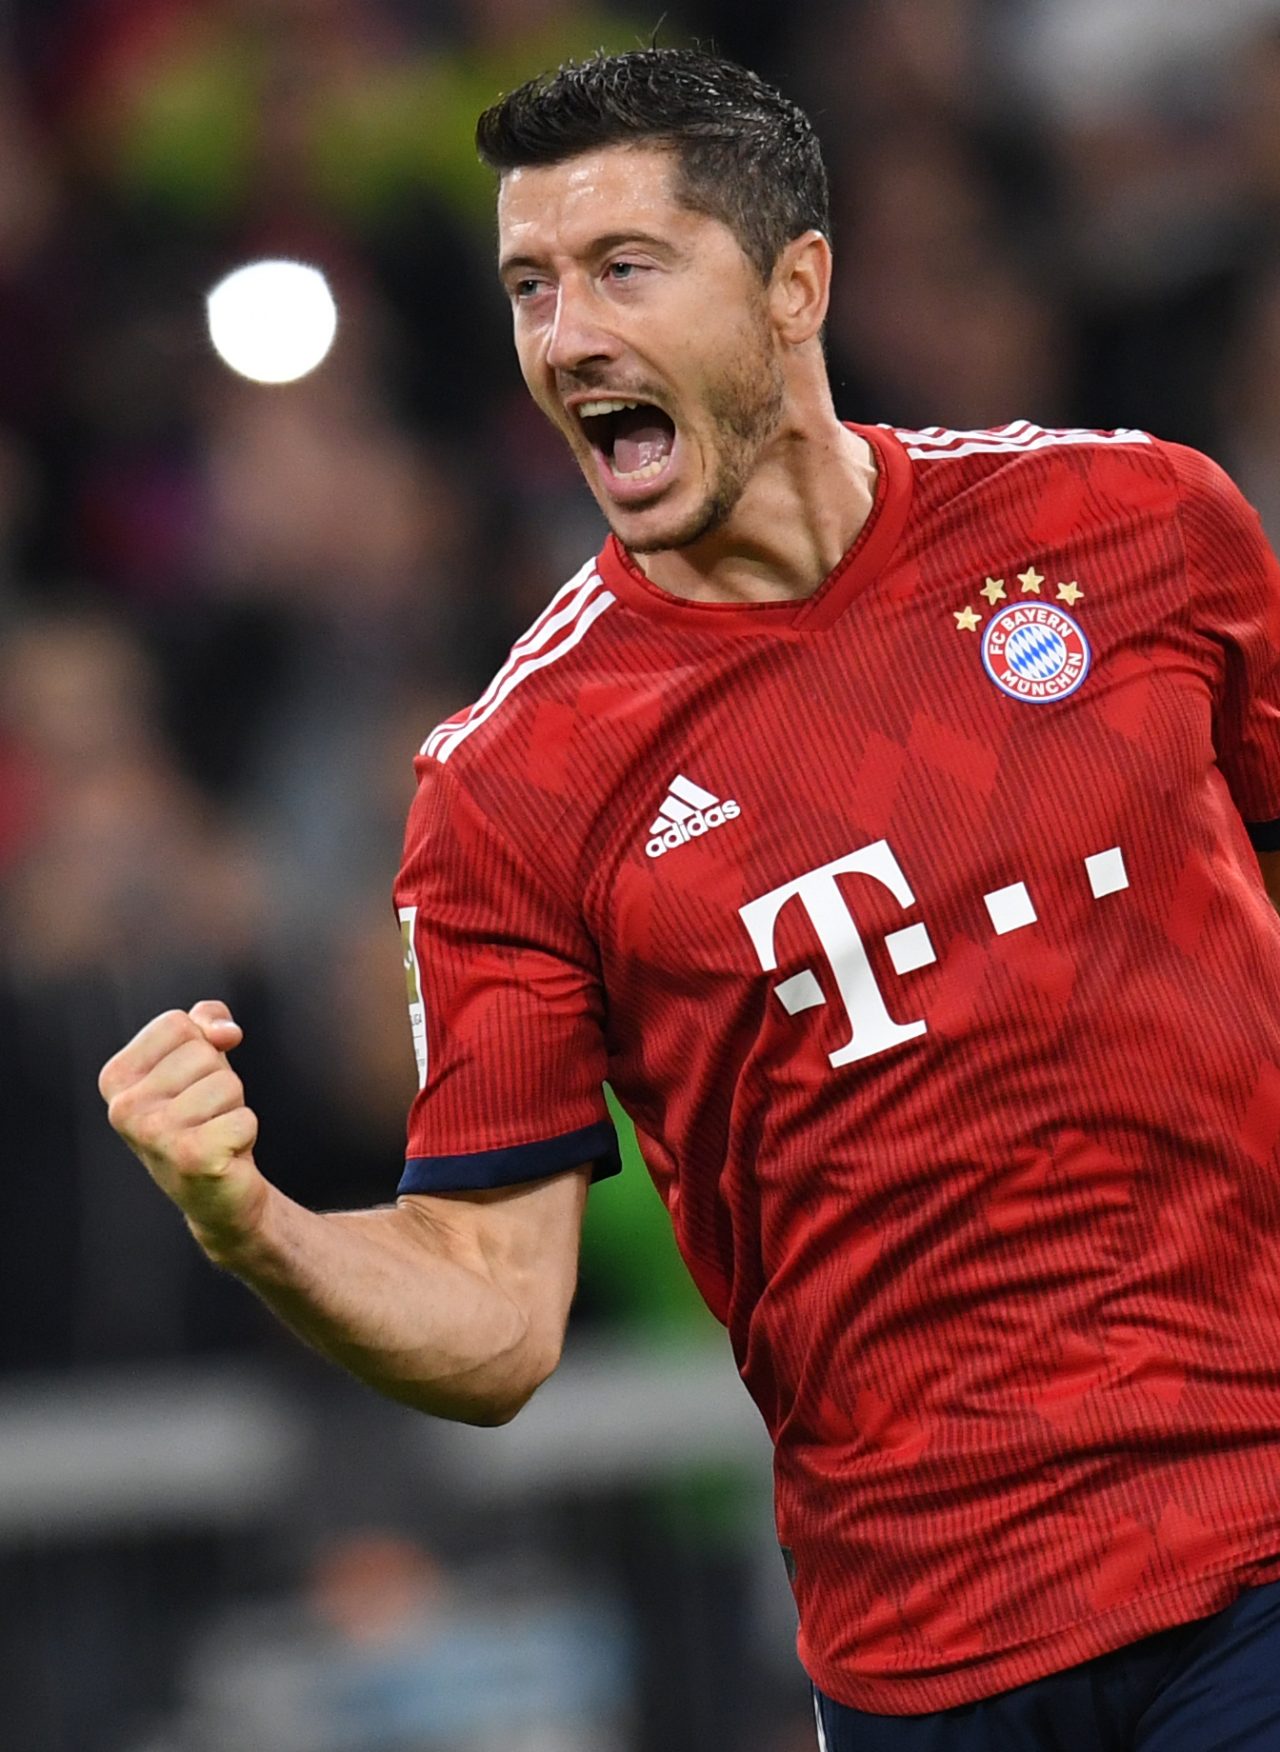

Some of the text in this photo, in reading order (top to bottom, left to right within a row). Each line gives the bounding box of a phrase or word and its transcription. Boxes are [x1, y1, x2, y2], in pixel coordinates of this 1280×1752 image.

[990, 609, 1073, 655] FC BAYERN
[645, 800, 741, 858] adidas
